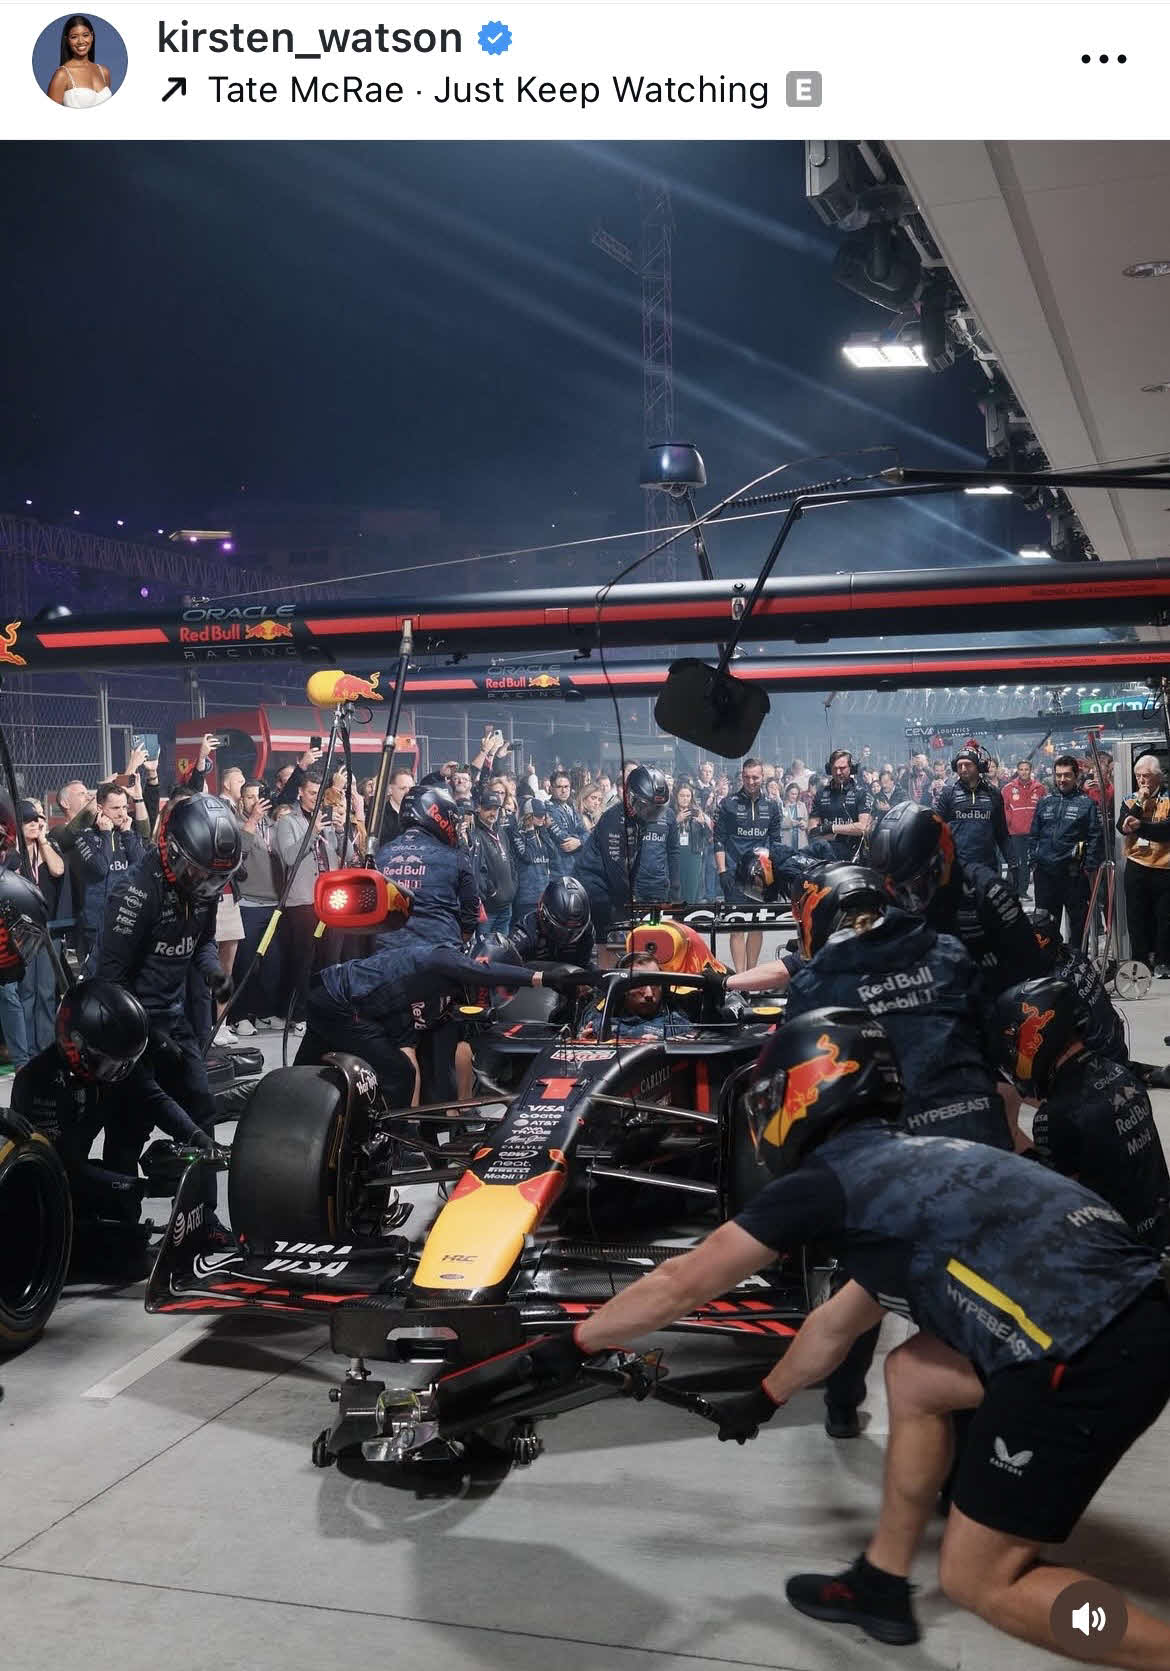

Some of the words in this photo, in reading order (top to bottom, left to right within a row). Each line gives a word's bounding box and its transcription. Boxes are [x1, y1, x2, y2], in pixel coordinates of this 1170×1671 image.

[182, 604, 297, 622] ORACLE
[179, 626, 209, 643] Red
[211, 623, 241, 641] Bull
[487, 664, 561, 677] ORACLE
[485, 678, 506, 689] Red
[506, 677, 526, 688] Bull
[955, 810, 973, 819] Red
[974, 810, 991, 820] Bull
[737, 827, 753, 837] Red
[383, 865, 403, 876] Red
[404, 864, 426, 876] Bull
[154, 938, 186, 956] Red
[857, 976, 897, 1002] Red
[894, 965, 934, 989] Bull
[868, 991, 920, 1016] Mobil
[528, 1104, 565, 1112] VISA
[905, 1096, 992, 1130] HYPEBEAST
[946, 1282, 1034, 1363] HYPEBEAST
